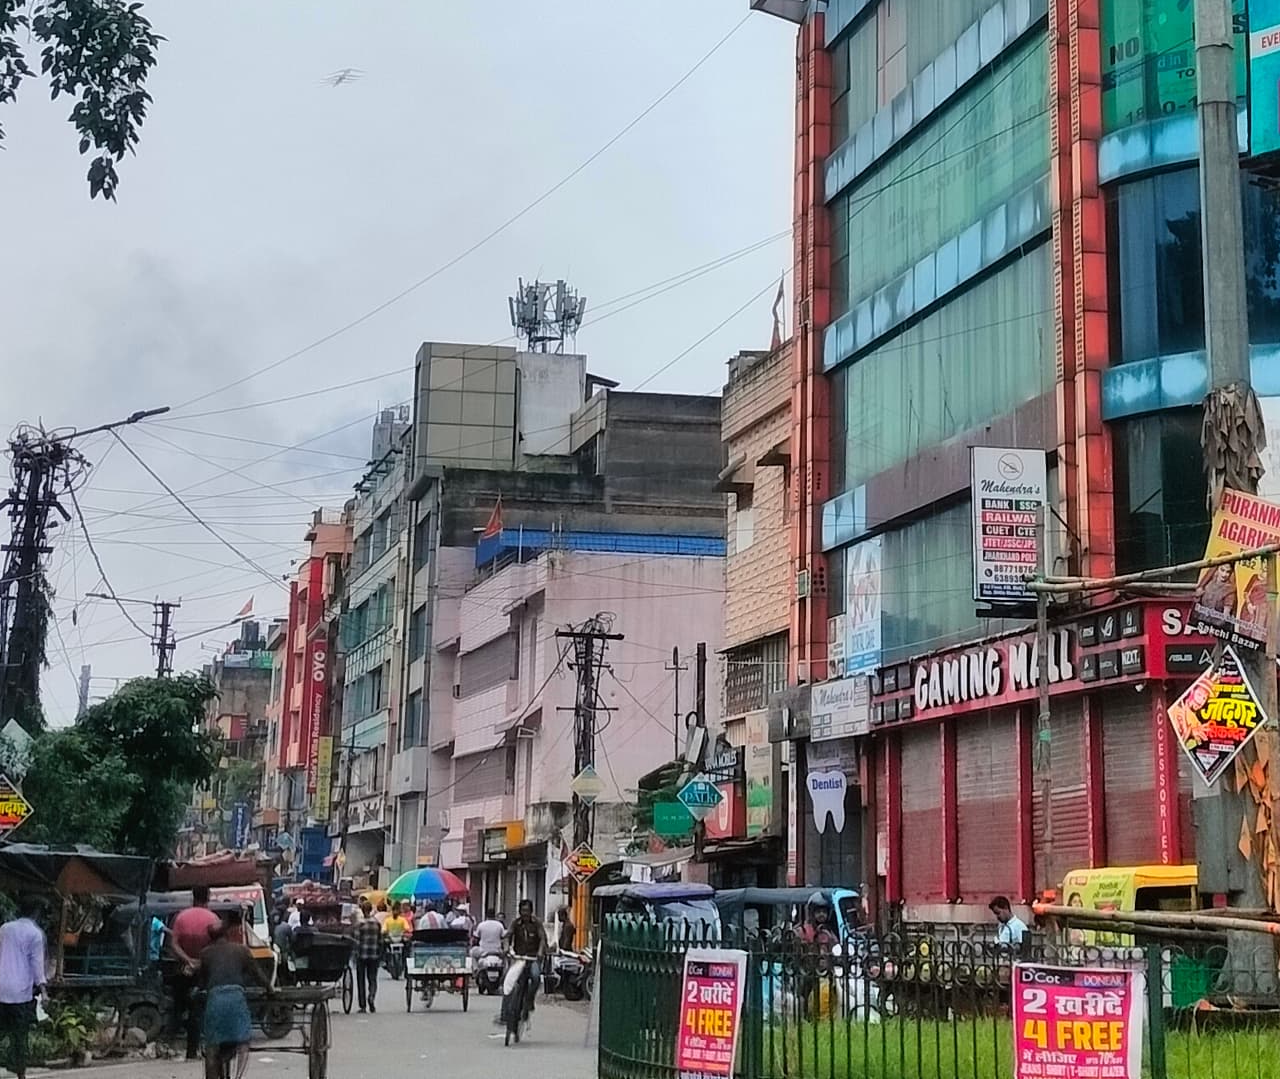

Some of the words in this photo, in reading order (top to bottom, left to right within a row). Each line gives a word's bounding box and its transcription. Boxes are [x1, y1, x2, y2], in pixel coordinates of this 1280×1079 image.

[981, 479, 1041, 495] Mahendra's
[984, 499, 1010, 510] BANK
[1019, 500, 1038, 511] SSC
[986, 512, 1038, 524] RAILWAY
[983, 537, 1038, 550] JTET/JSSC/JPS
[986, 525, 1010, 536] CUET
[1017, 526, 1036, 537] CTE
[1020, 552, 1038, 563] POLI
[1196, 621, 1231, 640] Sakchi
[1231, 631, 1261, 651] Bazar
[313, 650, 325, 682] OYO
[915, 647, 1002, 710] GAMING
[311, 693, 323, 738] Residency
[1200, 697, 1257, 729] जादूगर
[811, 776, 844, 792] Dentist
[1156, 697, 1168, 864] ACCESSORIES
[687, 981, 698, 1003] 2
[1023, 989, 1048, 1014] 2
[1054, 990, 1126, 1016] खरीदें
[686, 1008, 696, 1034] 4
[699, 1008, 733, 1037] FREE
[1023, 1019, 1048, 1049] 4
[1056, 1020, 1125, 1050] FREE
